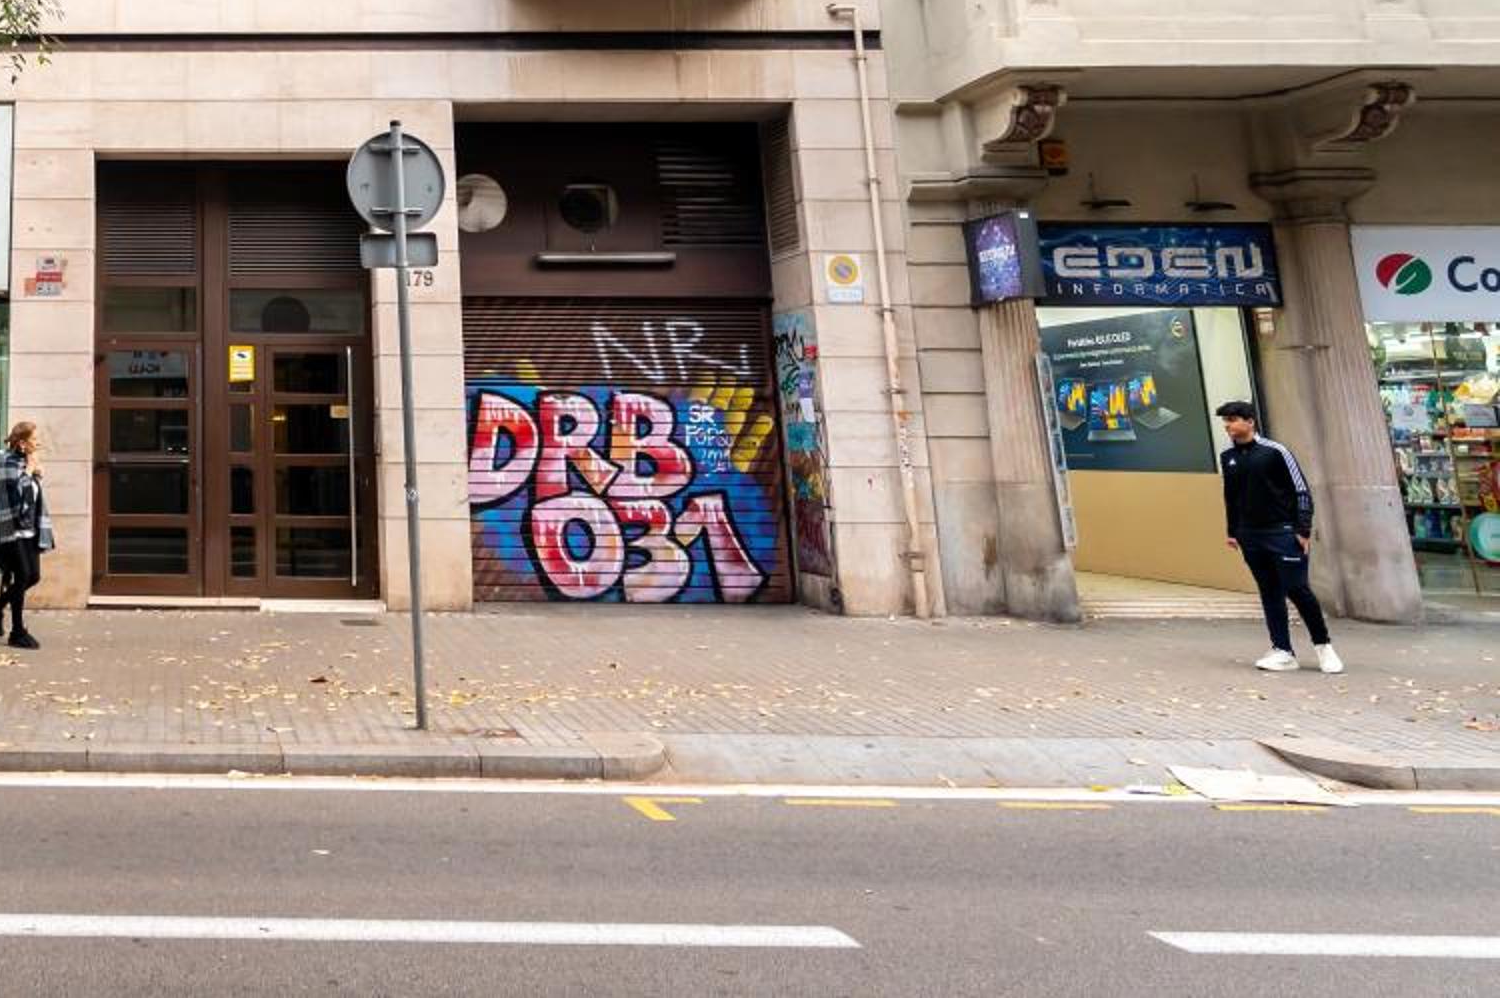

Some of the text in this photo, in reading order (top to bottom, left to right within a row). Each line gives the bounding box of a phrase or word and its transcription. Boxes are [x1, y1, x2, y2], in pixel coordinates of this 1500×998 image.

[1052, 243, 1265, 279] EDEN
[1057, 282, 1270, 296] INFORMATICA
[465, 389, 693, 507] DRB
